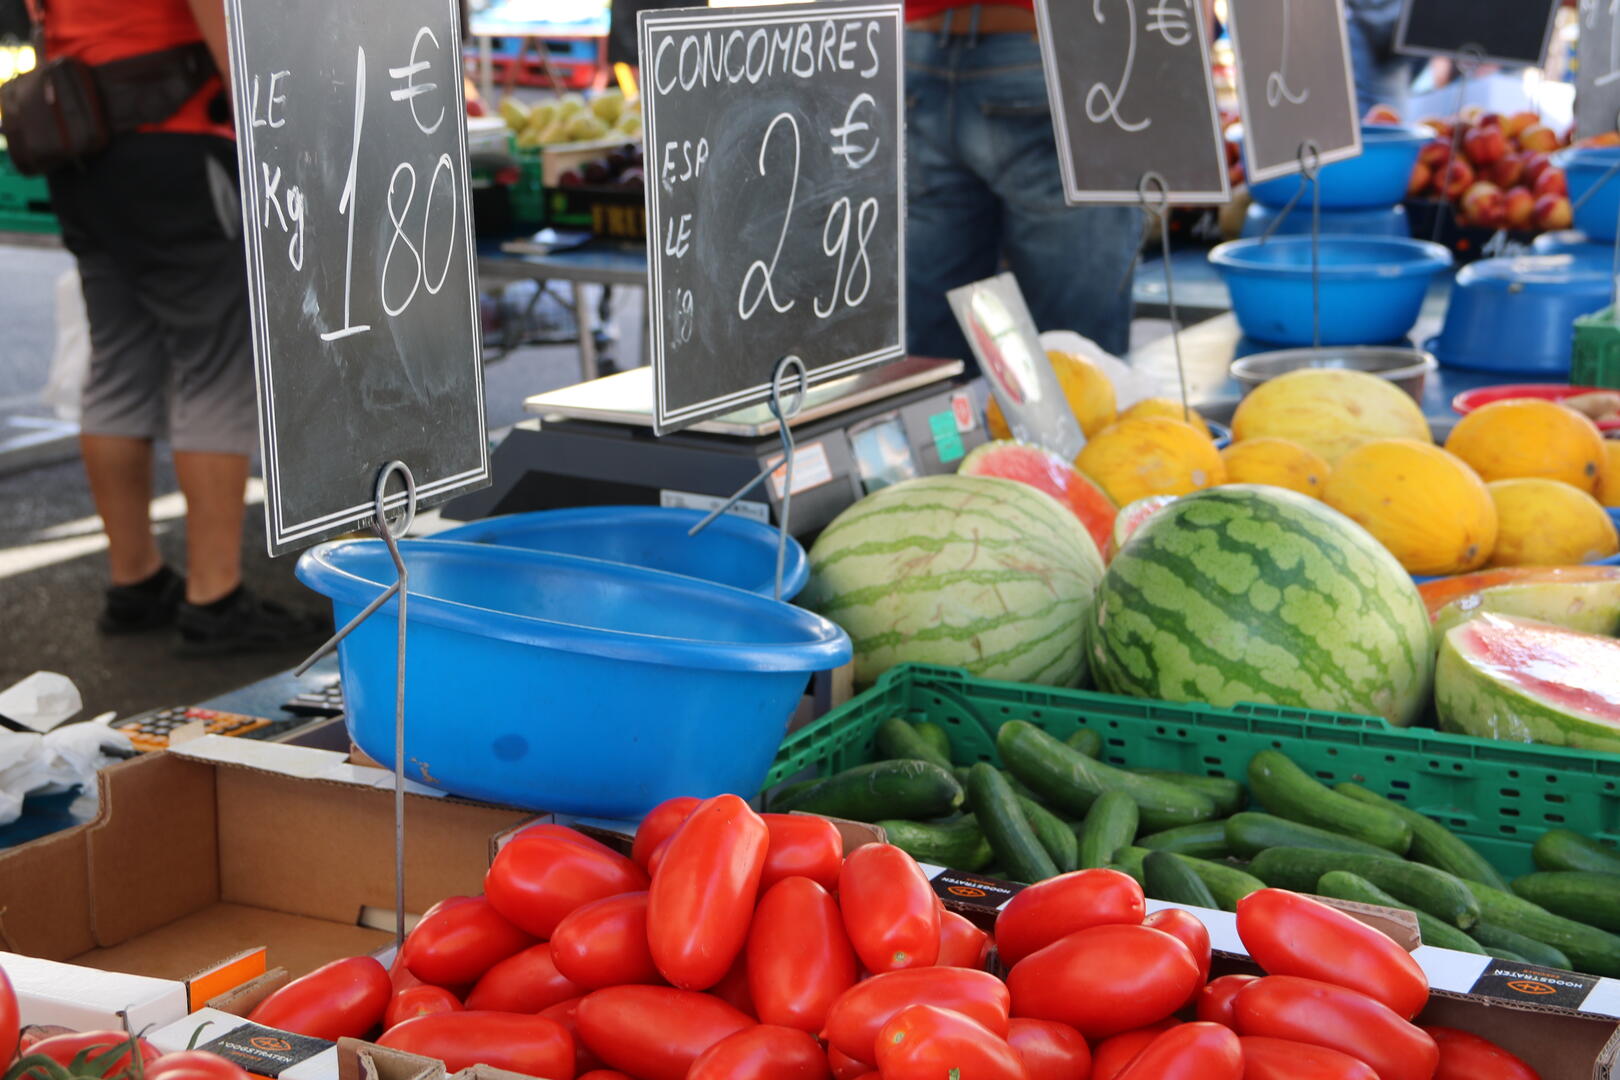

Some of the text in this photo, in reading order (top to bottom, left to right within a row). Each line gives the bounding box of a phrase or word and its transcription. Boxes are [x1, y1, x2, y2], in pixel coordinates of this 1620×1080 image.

[654, 19, 880, 95] CONCOMBRES
[252, 70, 291, 128] LE
[320, 26, 457, 341] 1 € 80
[661, 137, 709, 184] ESP
[262, 162, 305, 272] Kg
[665, 213, 692, 258] LE
[738, 93, 880, 320] 2 € 98
[1494, 968, 1583, 989] HOOGSTRATEN
